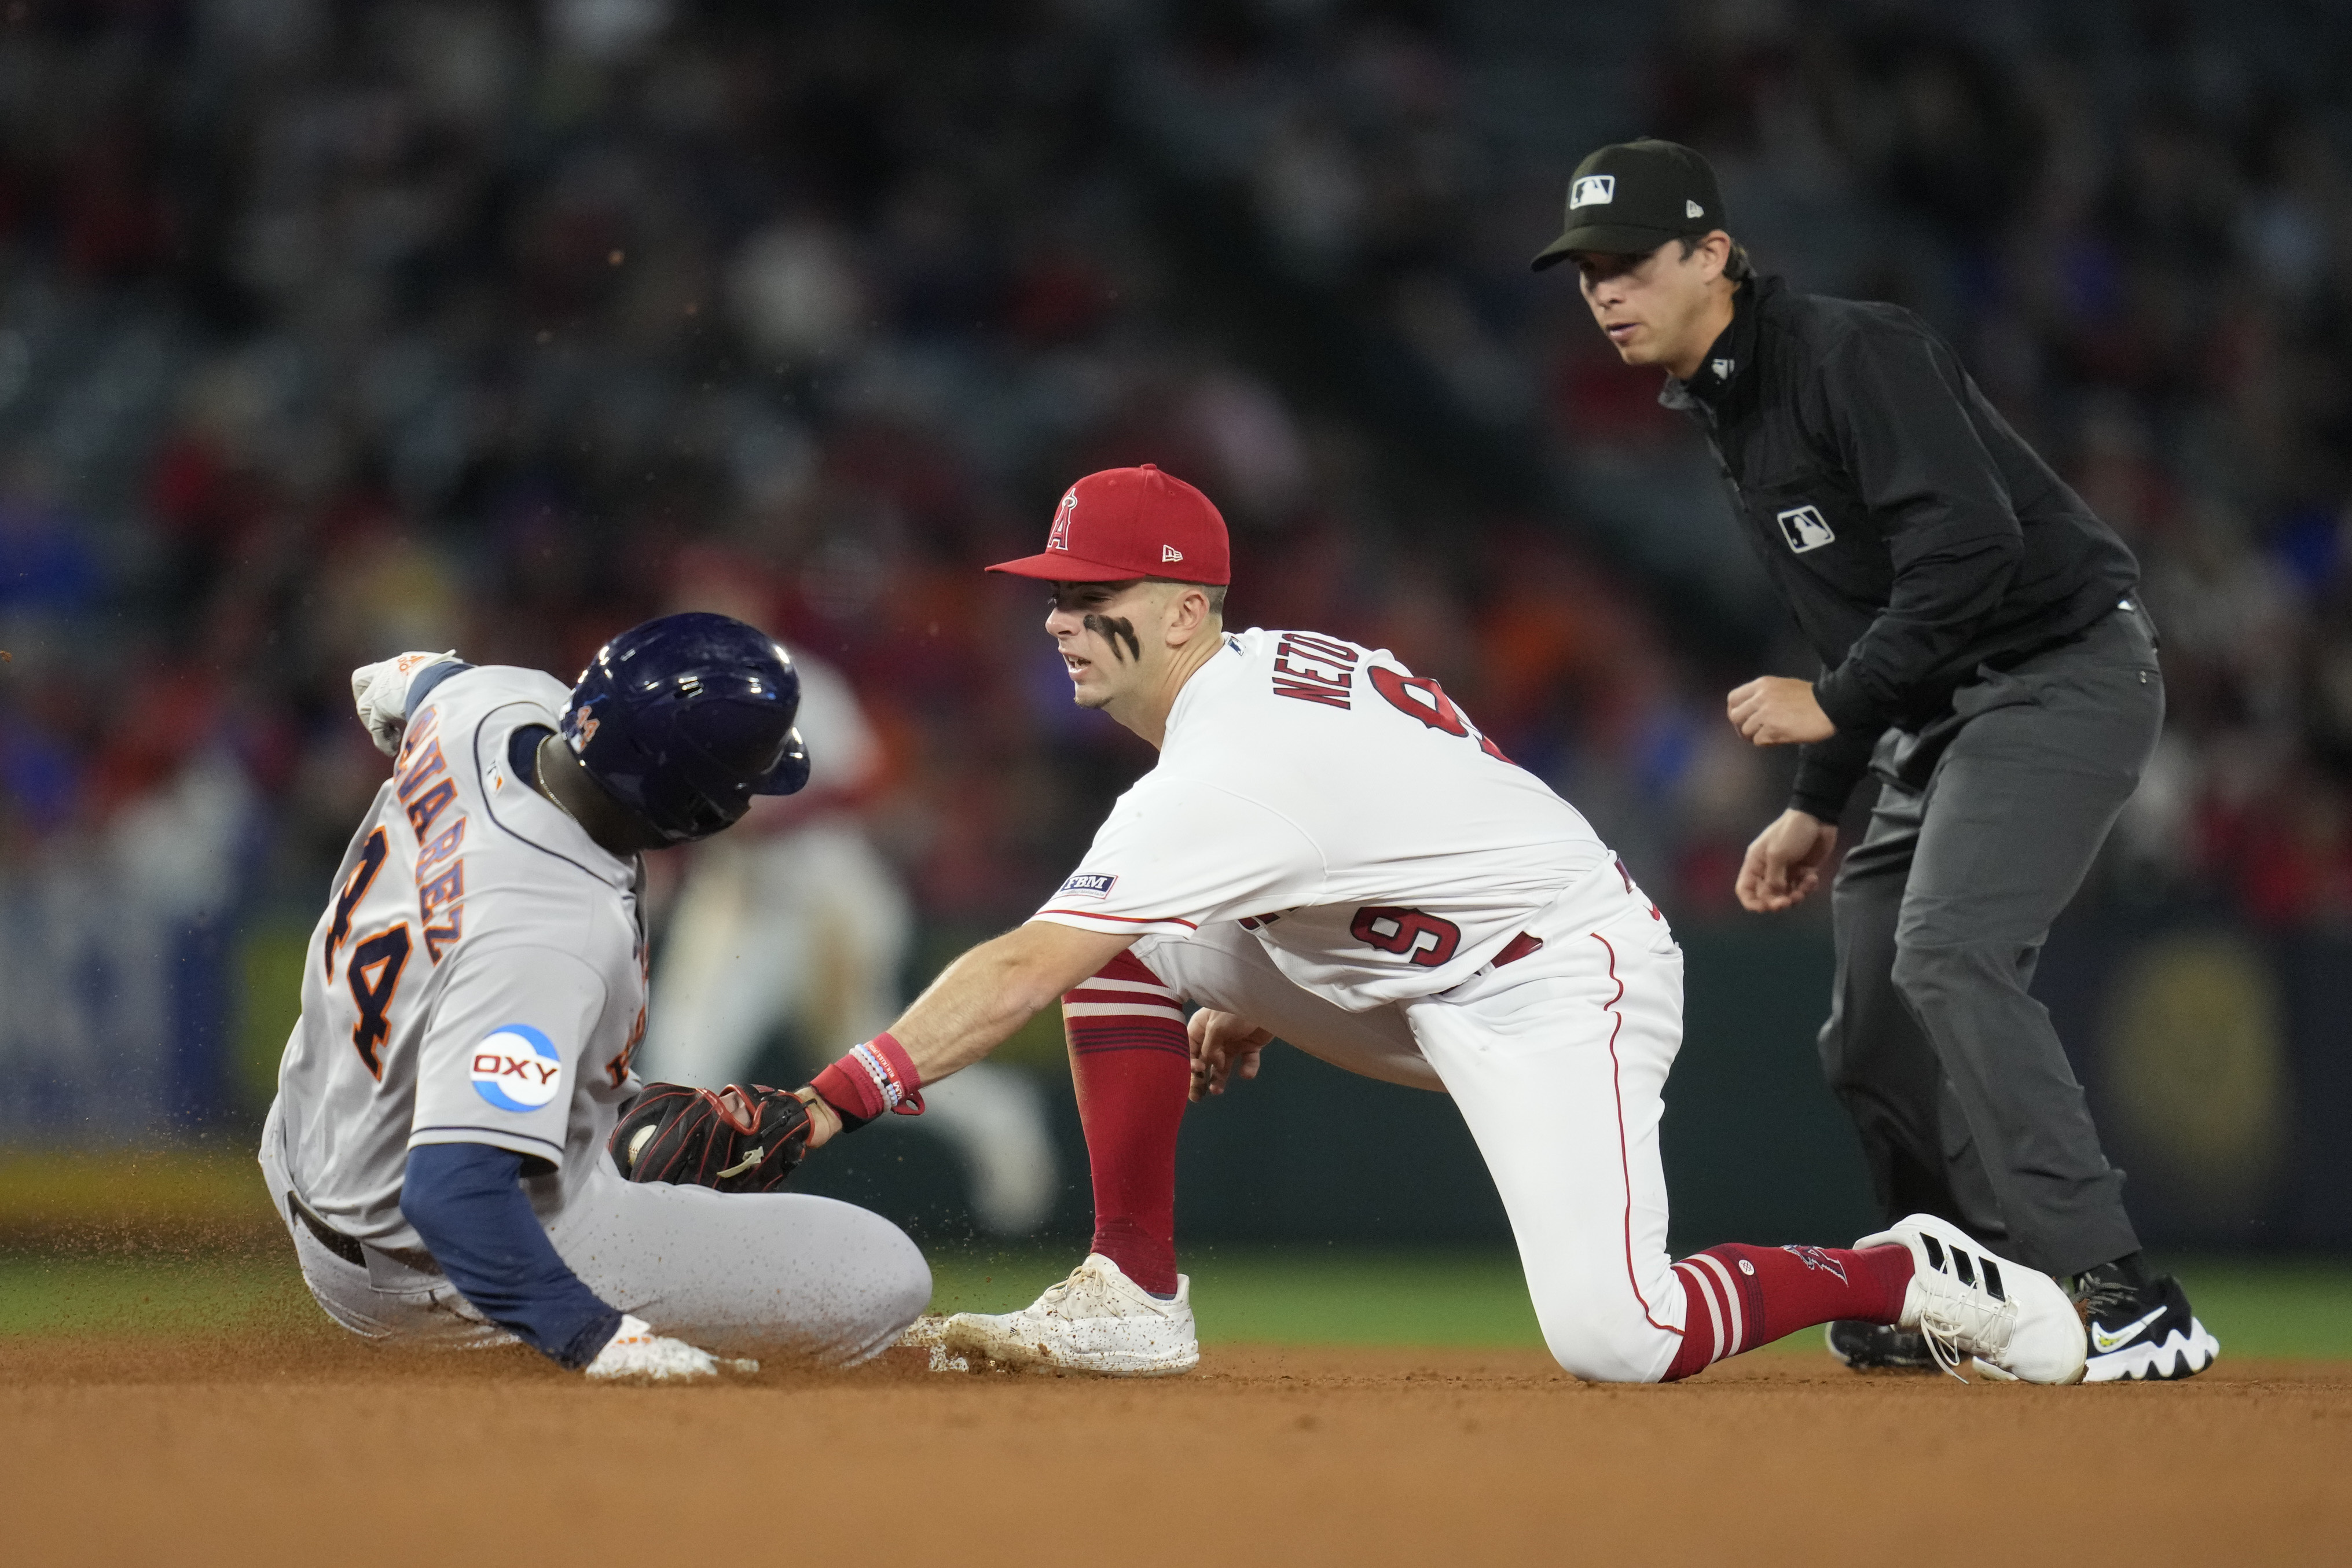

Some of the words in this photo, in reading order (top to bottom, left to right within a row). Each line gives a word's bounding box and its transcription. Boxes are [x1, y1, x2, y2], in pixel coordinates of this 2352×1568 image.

[1271, 633, 1359, 710] NETO
[1064, 876, 1108, 888] FBM
[1350, 906, 1462, 967] 9
[474, 1055, 558, 1085] OXY
